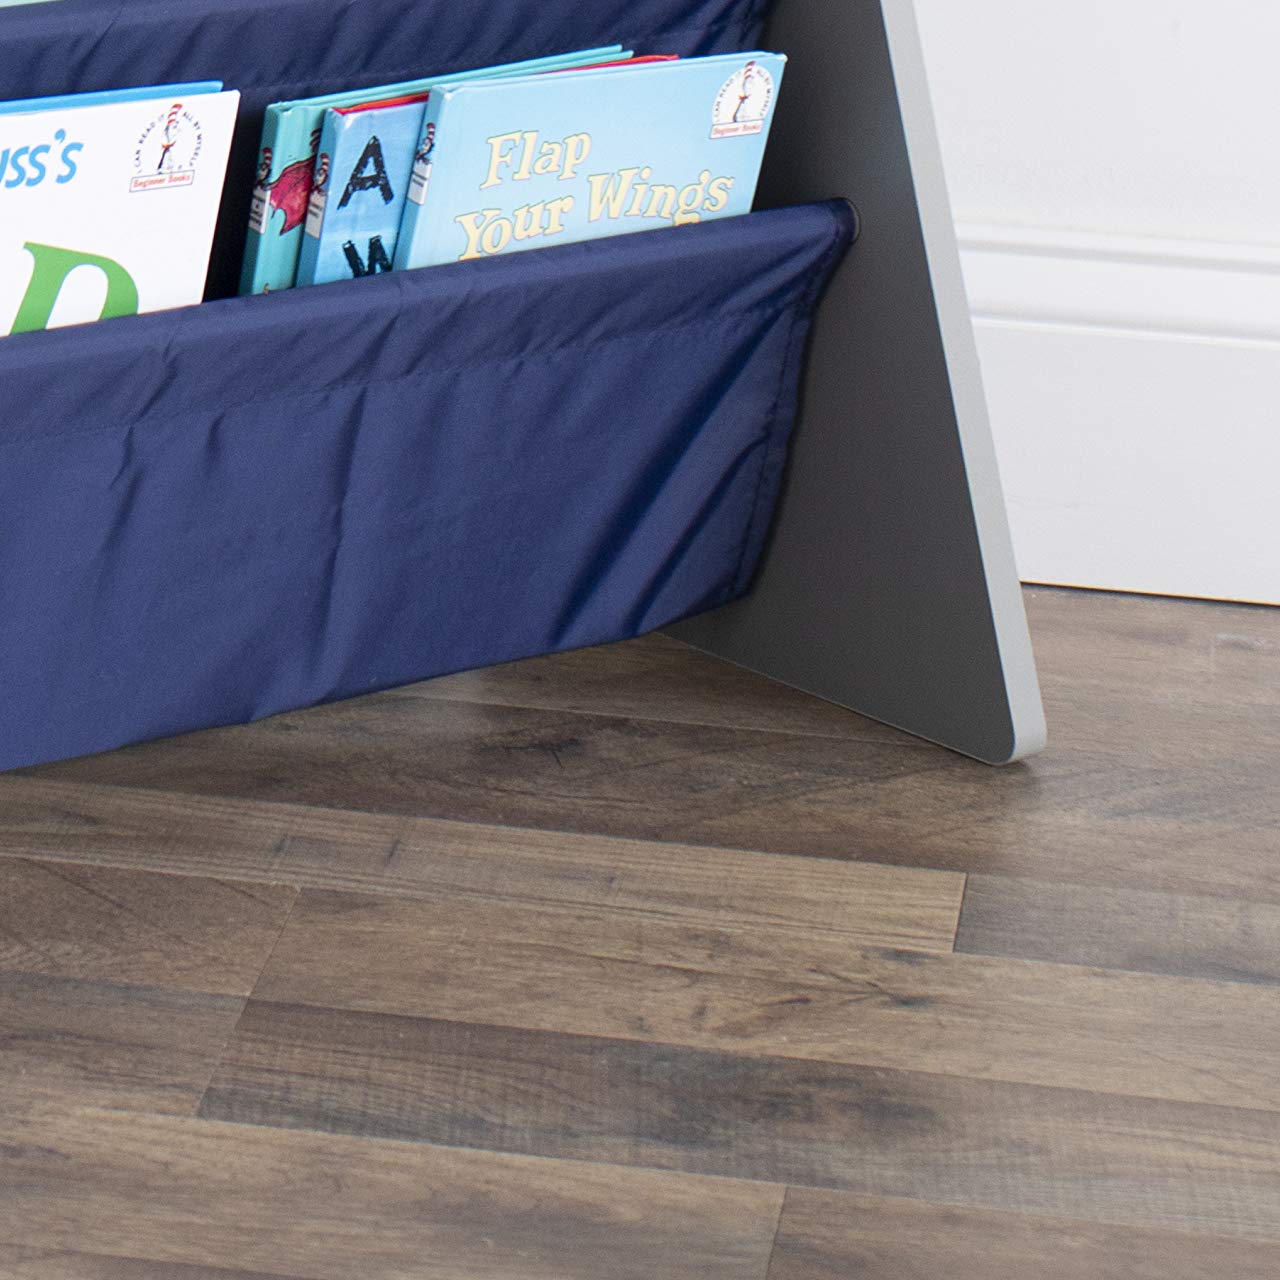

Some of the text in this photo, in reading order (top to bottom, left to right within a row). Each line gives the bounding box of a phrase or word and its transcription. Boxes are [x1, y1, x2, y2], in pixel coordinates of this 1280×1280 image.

[337, 135, 395, 211] A
[479, 130, 592, 190] Flap
[455, 166, 735, 262] Your Wings
